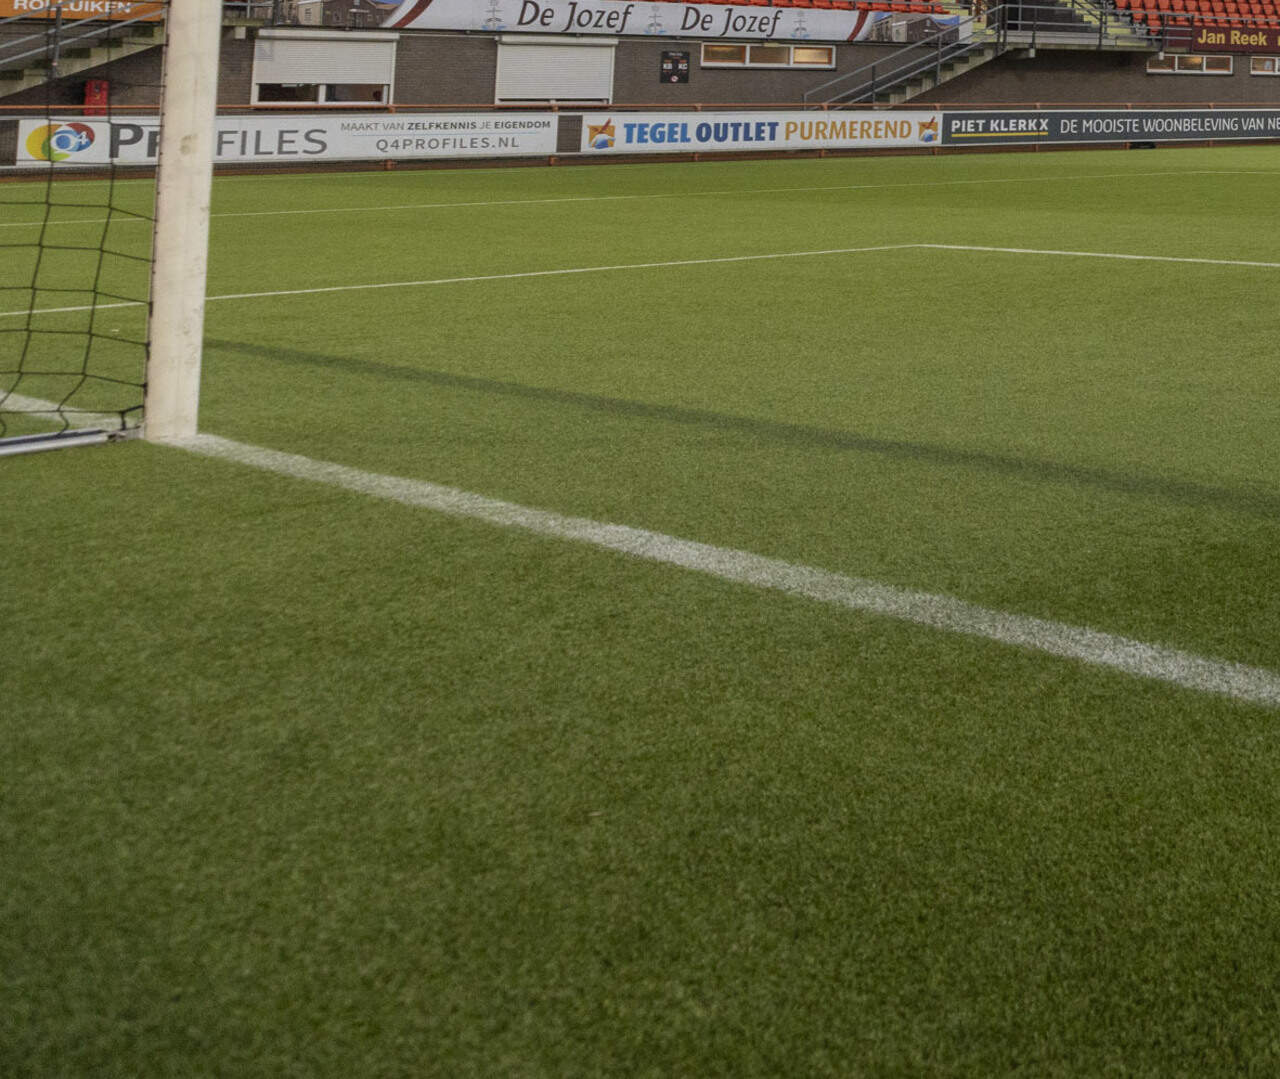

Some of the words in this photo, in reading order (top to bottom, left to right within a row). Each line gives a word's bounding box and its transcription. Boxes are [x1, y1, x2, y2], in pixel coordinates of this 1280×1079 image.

[517, 0, 555, 28] De
[562, 1, 634, 34] Jozef
[680, 6, 713, 32] De
[720, 8, 783, 37] Jozef
[1198, 29, 1226, 45] Jan
[1230, 30, 1267, 47] Reek
[340, 121, 379, 131] MAAKT
[382, 121, 405, 130] VAN
[407, 120, 477, 130] ZELFKENNIS
[479, 120, 491, 129] JE
[494, 119, 551, 129] EIGENDOM
[624, 122, 691, 144] TEGEL
[696, 121, 779, 143] OUTLET
[785, 119, 912, 142] PURMEREND
[951, 120, 987, 133] PIET
[989, 119, 1049, 132] KLERKX
[1060, 120, 1078, 133] DE
[1080, 119, 1140, 133] MOOISTE
[1142, 118, 1239, 133] WOONBELEVING
[1242, 117, 1265, 131] VAN
[110, 122, 327, 159] PFILES
[376, 135, 520, 152] Q4PROFILES.NL
